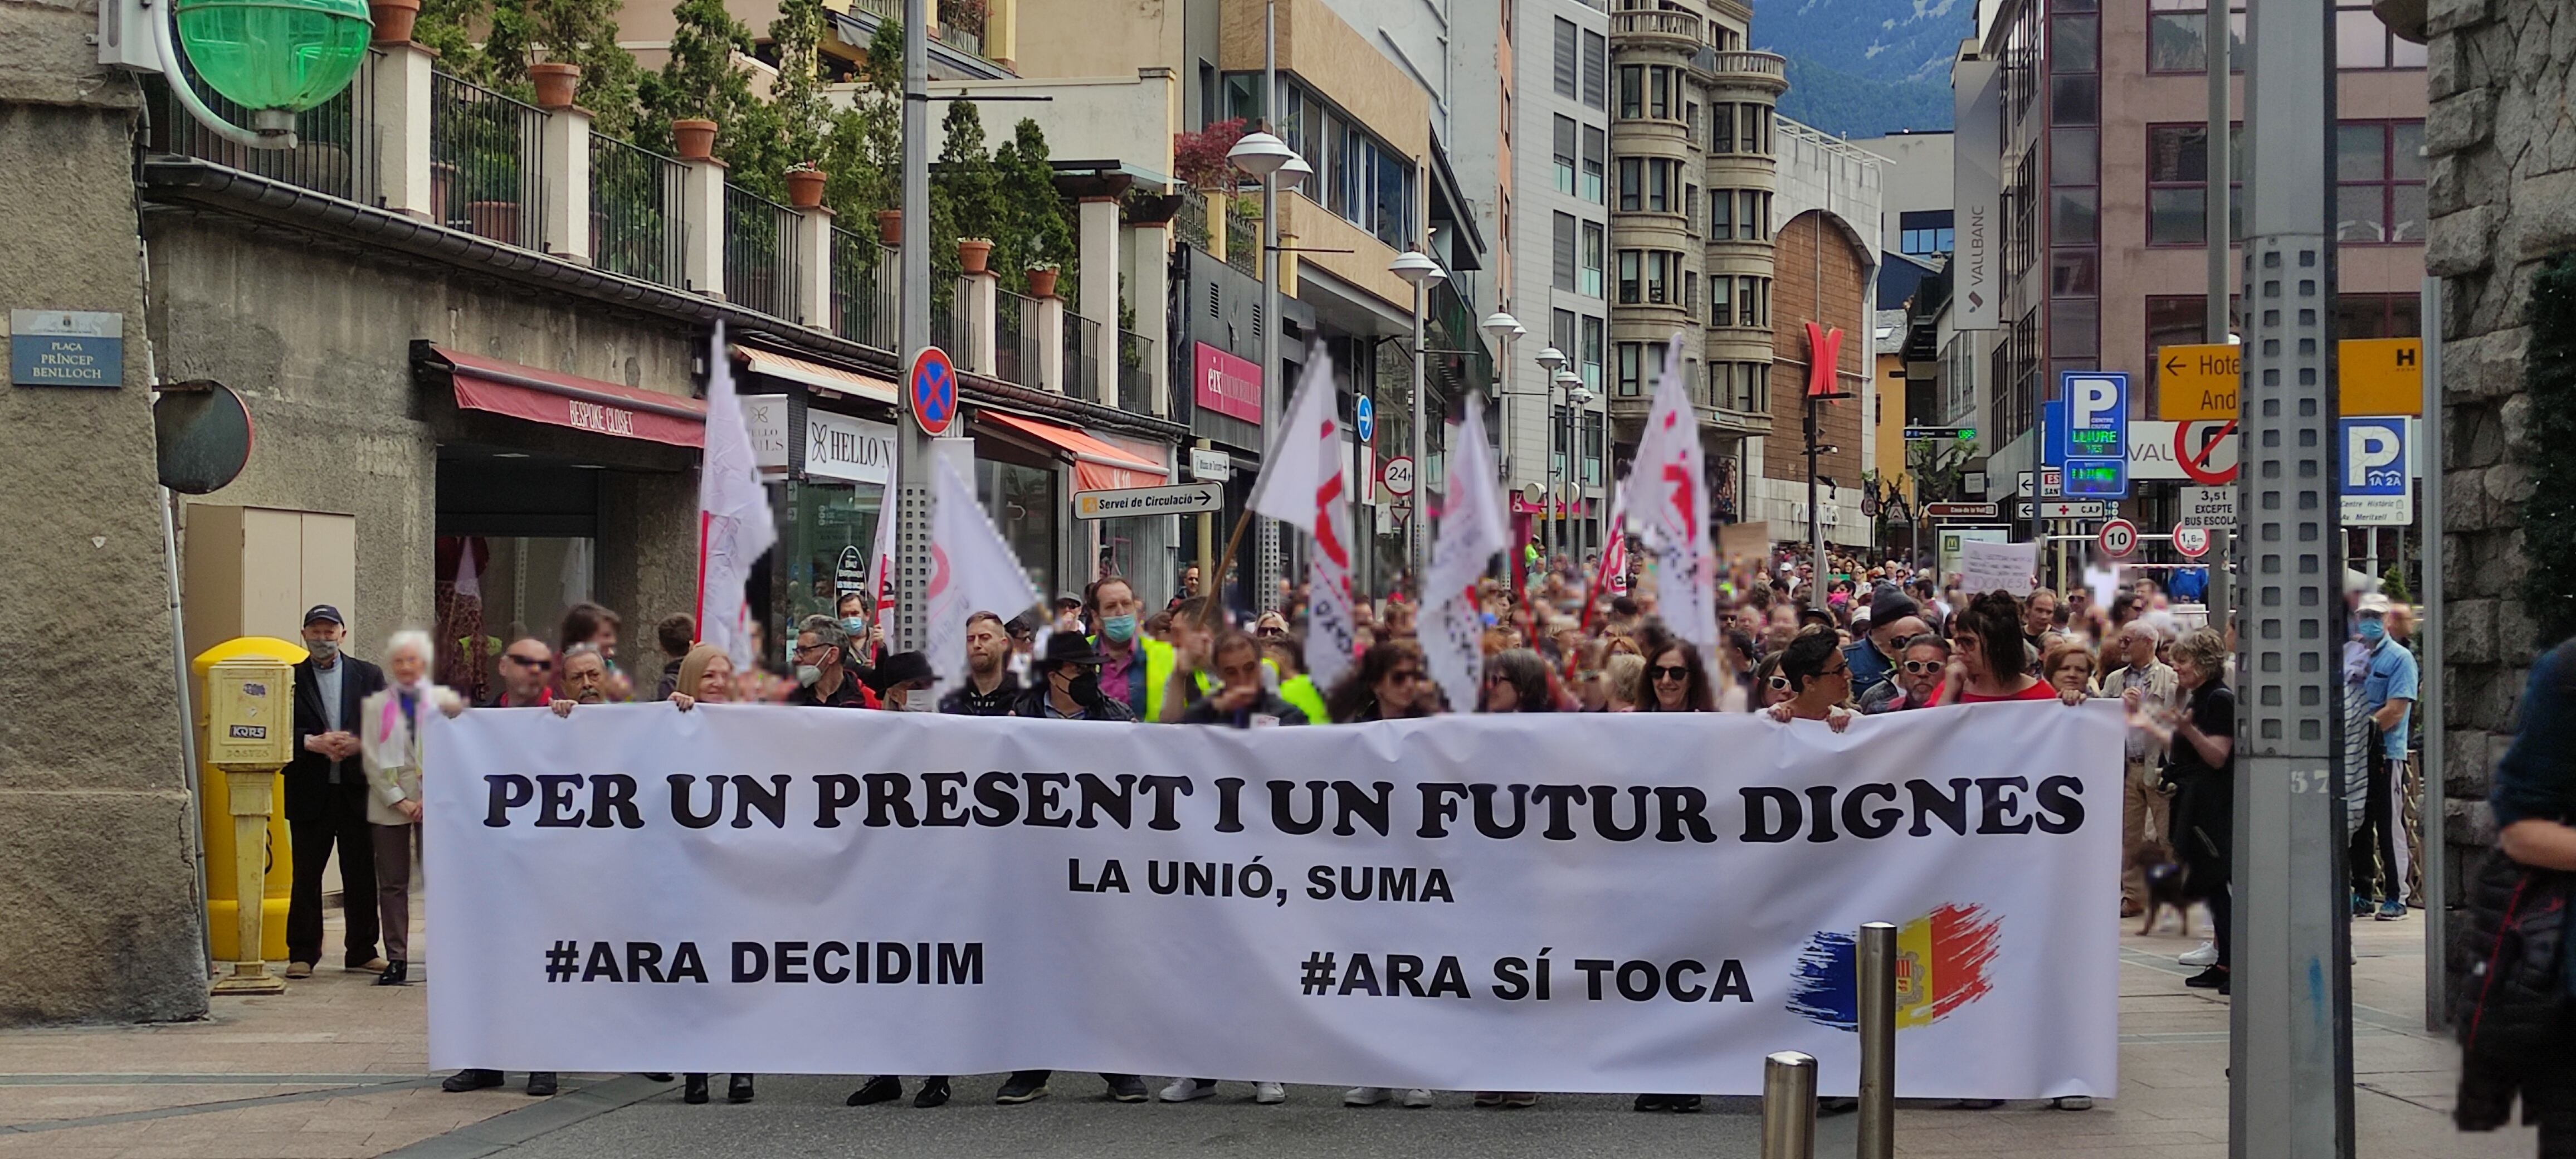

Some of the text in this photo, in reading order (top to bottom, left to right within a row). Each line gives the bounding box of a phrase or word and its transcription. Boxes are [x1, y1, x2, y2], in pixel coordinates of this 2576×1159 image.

[1971, 205, 1984, 286] VALLBANC
[51, 342, 82, 352] PLAÇA
[32, 367, 101, 379] BENLLOCH
[1207, 356, 1222, 395] eix
[569, 400, 633, 435] BESPOKE CLOSET
[2074, 379, 2118, 429] P
[2201, 389, 2236, 410] And
[831, 430, 878, 467] HELLO
[2072, 430, 2117, 443] LLIURE
[2348, 426, 2400, 486] P
[1099, 494, 1193, 510] Servei de Circulació
[2195, 504, 2232, 514] EXCEPTE
[2109, 532, 2127, 546] 10
[2184, 516, 2202, 526] BUS
[484, 771, 2085, 844] PER UN PRESENT I UN FUTUR DIGNES
[1069, 855, 1455, 907] LA UNIÓ, SUMA
[546, 940, 984, 985] #ARA DECIDIM
[1301, 947, 1754, 1003] #ARA SÍ TOCA
